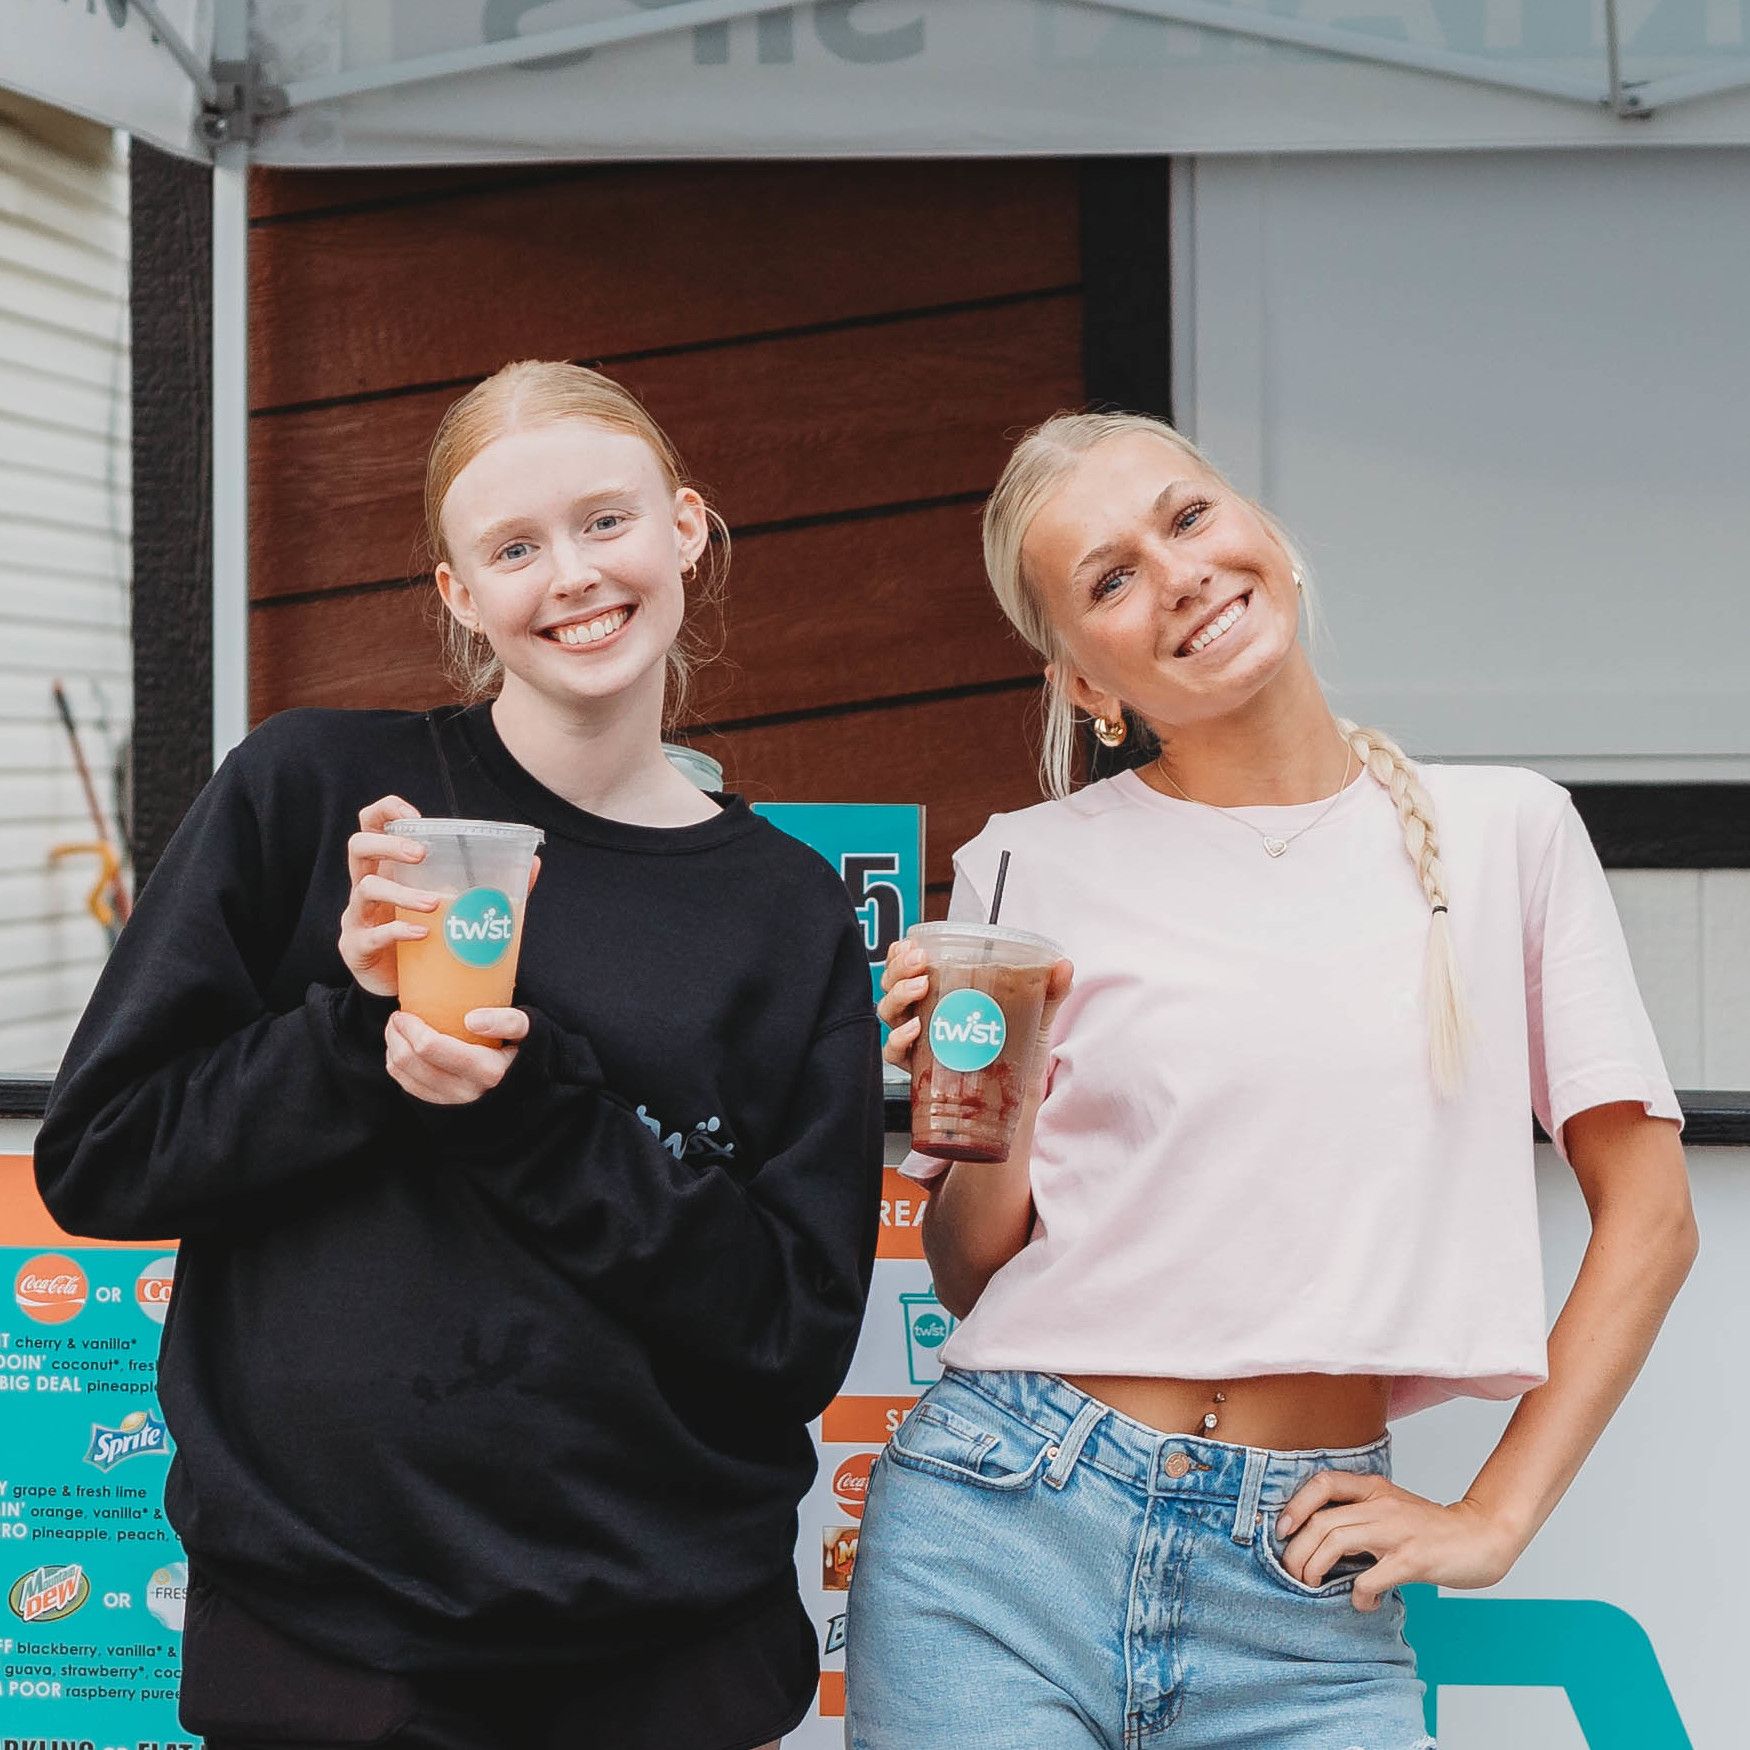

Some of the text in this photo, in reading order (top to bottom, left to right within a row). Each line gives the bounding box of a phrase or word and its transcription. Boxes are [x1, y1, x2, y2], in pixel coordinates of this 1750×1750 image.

[446, 907, 512, 941] twist
[933, 1011, 1001, 1046] twist
[95, 1286, 122, 1303] OR
[914, 1322, 946, 1337] twist
[15, 1336, 61, 1351] cherry
[67, 1337, 76, 1349] &
[36, 1376, 81, 1393] DEAL
[94, 1422, 161, 1463] Sprite
[13, 1486, 57, 1498] grape
[62, 1485, 71, 1497] &
[76, 1484, 111, 1498] fresh
[116, 1486, 147, 1498] lime
[153, 1508, 163, 1520] &
[103, 1592, 132, 1608] OR
[168, 1646, 177, 1658] &
[9, 1681, 61, 1697] POOR
[65, 1685, 136, 1701] raspberry
